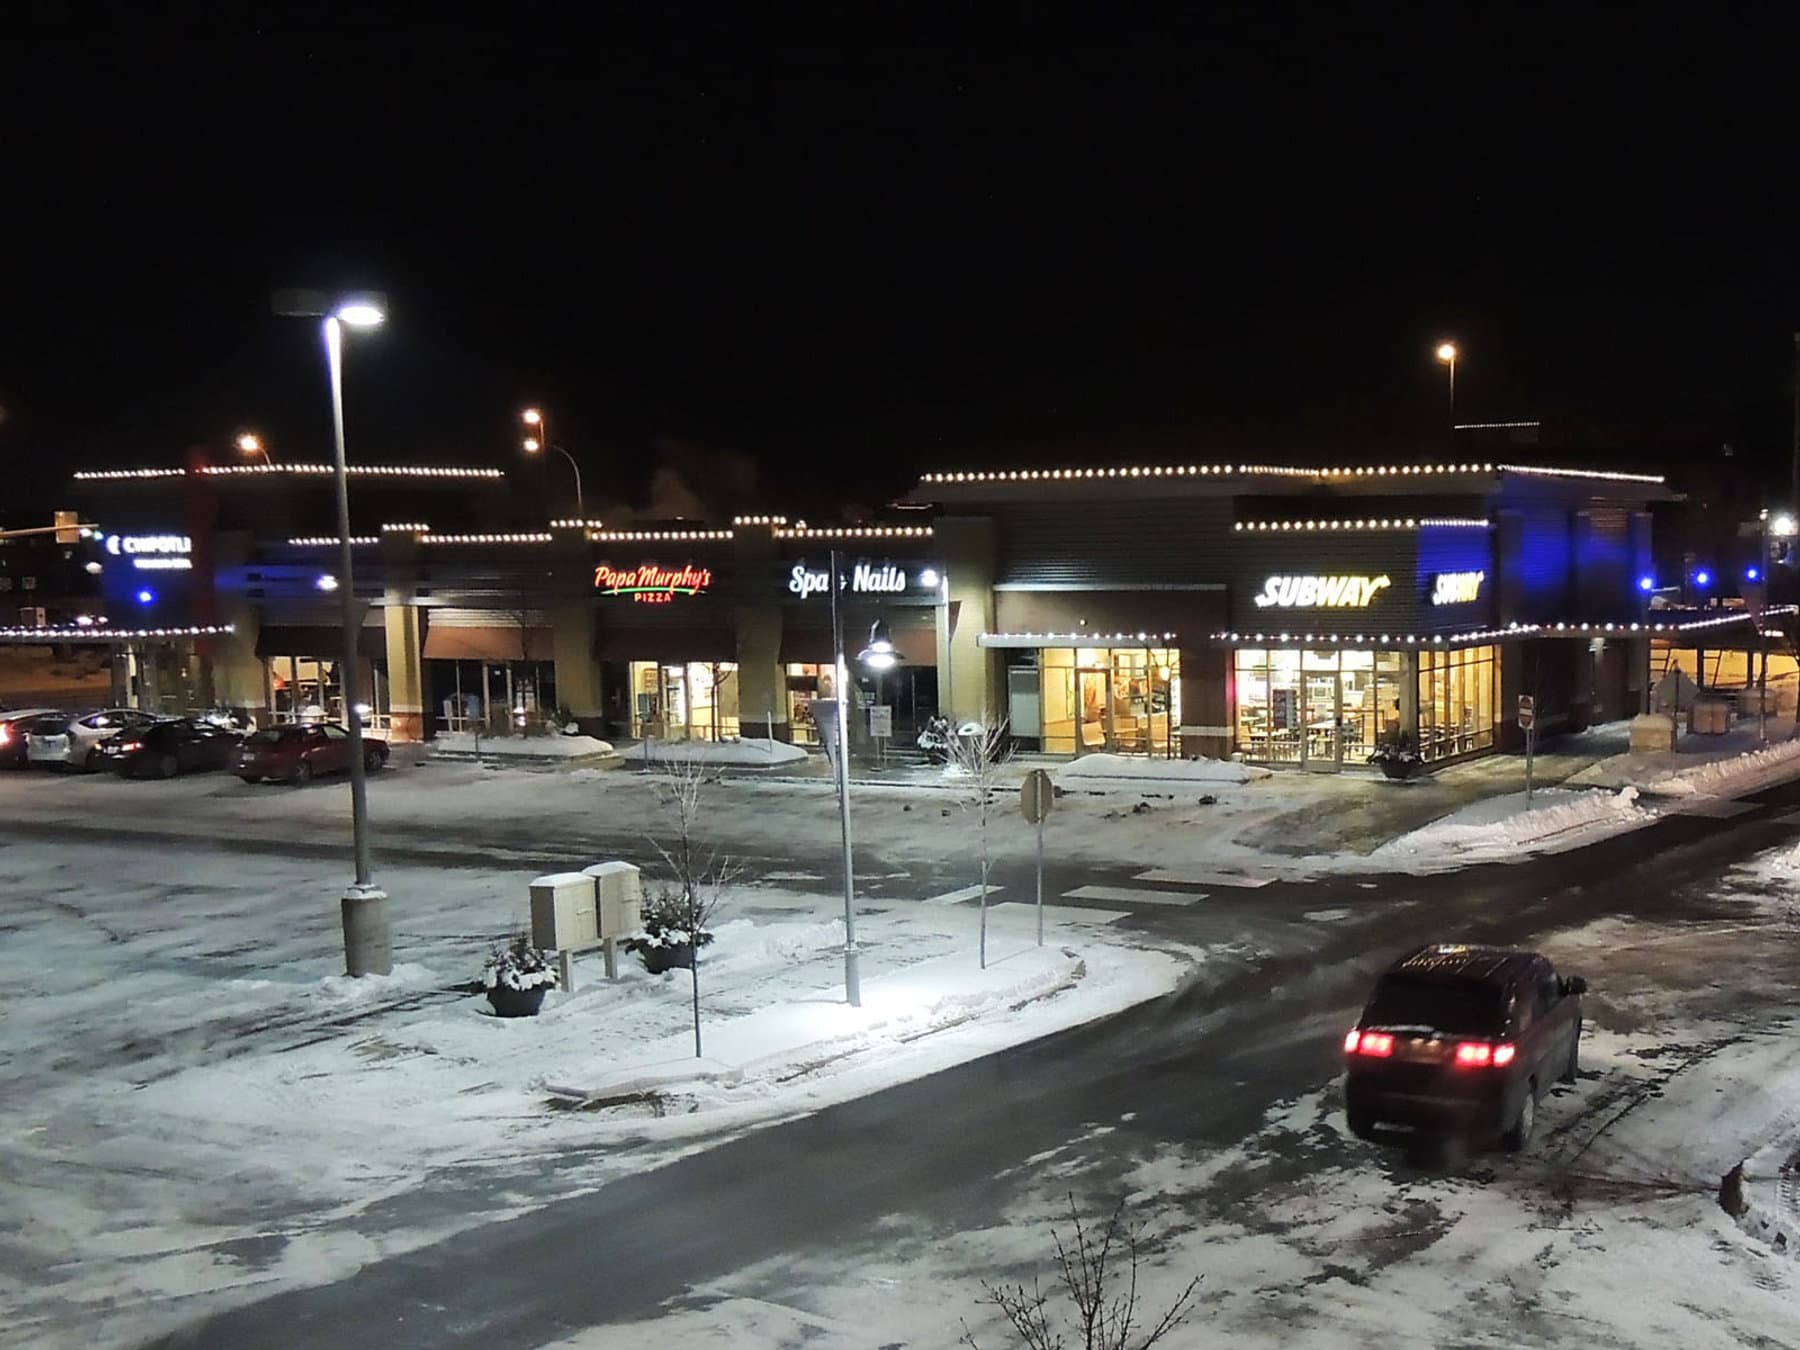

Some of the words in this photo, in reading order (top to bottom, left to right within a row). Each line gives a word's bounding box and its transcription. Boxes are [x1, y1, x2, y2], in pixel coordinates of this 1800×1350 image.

[595, 566, 637, 595] Papa
[638, 565, 711, 595] Murphy's
[789, 566, 829, 599] Spa
[853, 565, 906, 592] Nails
[1254, 574, 1391, 607] SUBWAY
[634, 592, 672, 602] PIZZA
